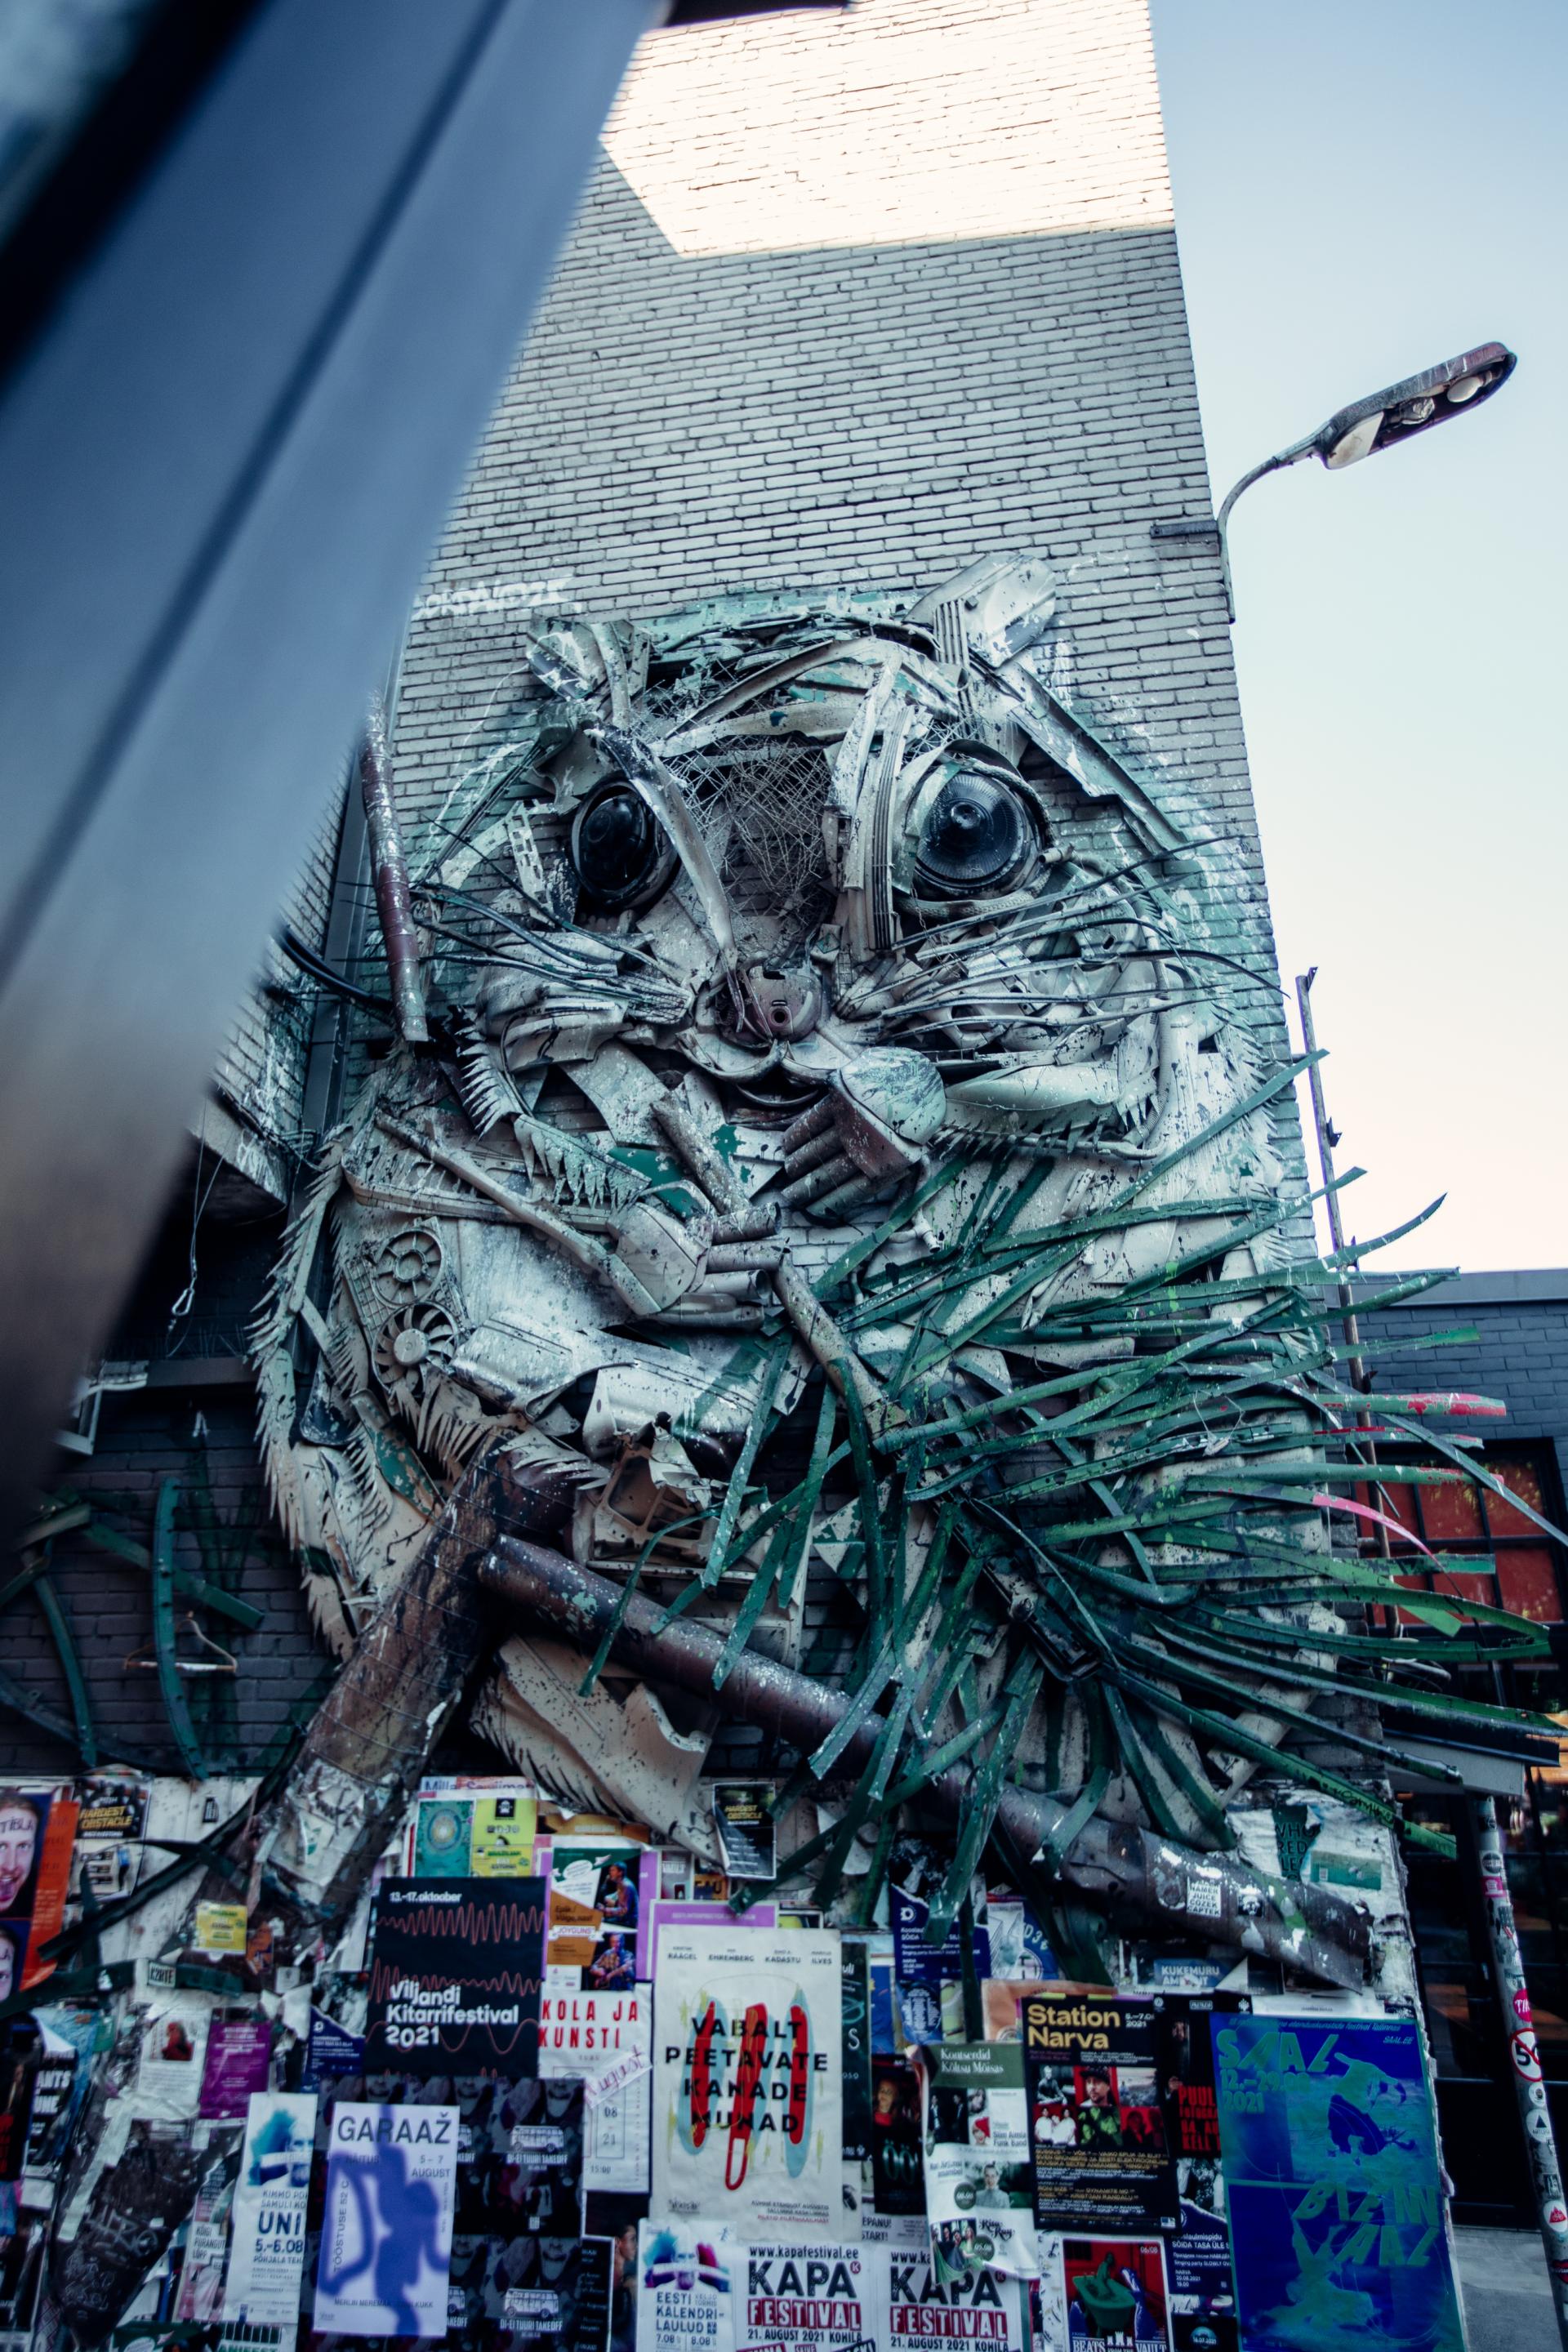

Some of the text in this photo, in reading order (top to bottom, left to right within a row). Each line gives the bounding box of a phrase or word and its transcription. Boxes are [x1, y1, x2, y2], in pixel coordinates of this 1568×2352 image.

[79, 1806, 127, 1819] HARDEST
[82, 1815, 133, 1829] OBSTACLE
[1161, 1966, 1220, 1976] KUKEMURU
[390, 1979, 461, 2007] Viljandi
[386, 2003, 519, 2025] Kitarrifestival
[542, 1999, 639, 2022] KOLA JA
[1027, 2003, 1121, 2028] Station
[385, 2025, 439, 2048] 2021
[537, 2026, 621, 2050] KUNSTI
[692, 2017, 803, 2038] VABALT
[1027, 2025, 1109, 2050] Narva
[665, 2046, 828, 2072] PEETAVATE
[1216, 2029, 1339, 2074] SAAL
[684, 2078, 807, 2102] KANADE
[1223, 2091, 1265, 2114] 2021
[338, 2111, 452, 2145] GARAAŽ
[692, 2110, 799, 2133] MUNAD
[412, 2167, 451, 2178] AUGUST
[258, 2210, 303, 2236] UNI
[750, 2245, 858, 2260] www.kapafestival.ee
[1211, 2240, 1225, 2249] ÜLE
[1334, 2223, 1440, 2268] AAL
[748, 2261, 857, 2298] KAPA
[657, 2292, 692, 2304] EESTI
[656, 2305, 724, 2320] KALENDRI-
[750, 2299, 862, 2330] FESTIVAL
[892, 2305, 1007, 2340] FESTIVAL
[536, 2319, 563, 2332] TAKEOFF
[656, 2319, 704, 2333] LAULUD
[748, 2329, 862, 2344] 21. AUGUST 2021 KOHILA
[656, 2333, 675, 2344] 7.08
[691, 2336, 710, 2346] 8.08
[891, 2336, 1009, 2352] 21. AUGUST 2021 KOHILA
[1072, 2340, 1106, 2352] BEATS
